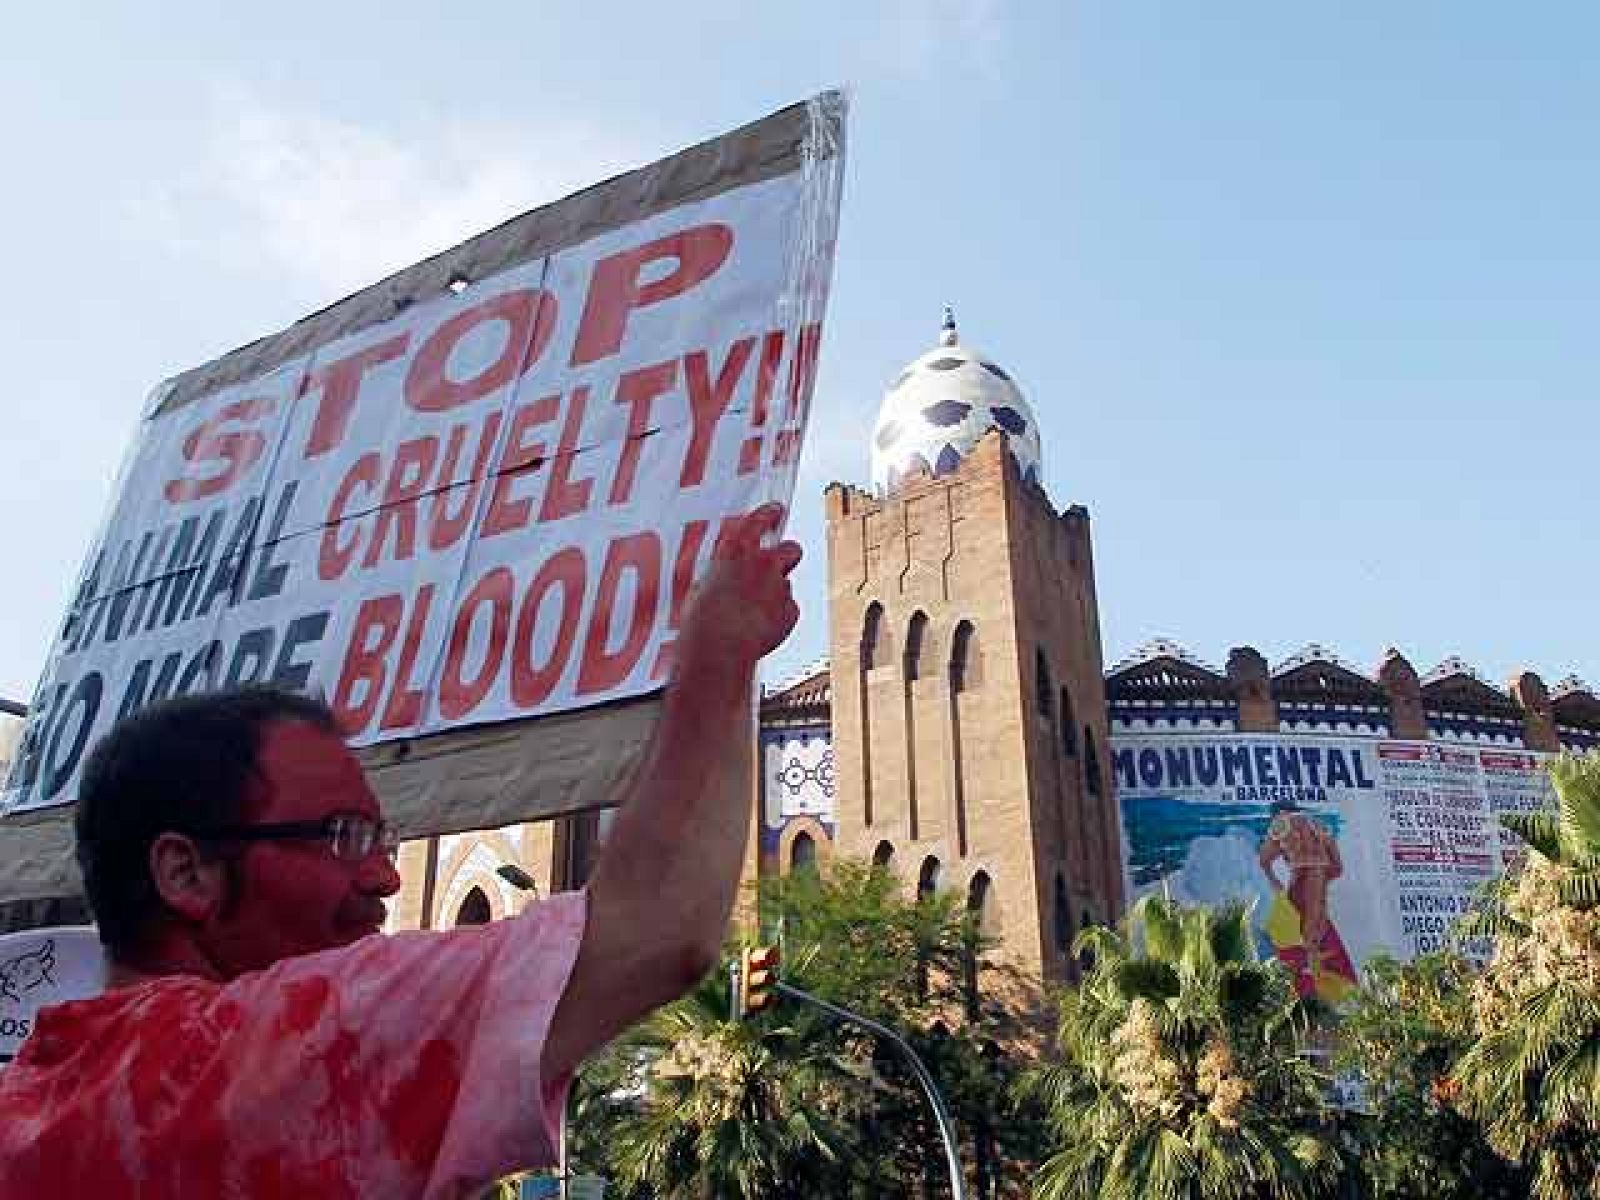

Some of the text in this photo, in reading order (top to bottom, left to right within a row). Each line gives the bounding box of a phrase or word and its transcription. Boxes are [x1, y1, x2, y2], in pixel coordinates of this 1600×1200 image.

[164, 222, 734, 504] STOP
[62, 480, 300, 655] ANIMAL
[1113, 746, 1374, 789] MONUMENTAL
[1236, 787, 1327, 801] BARCELONA
[1400, 895, 1456, 913] ANTONIO
[1402, 915, 1445, 933] DIEGO
